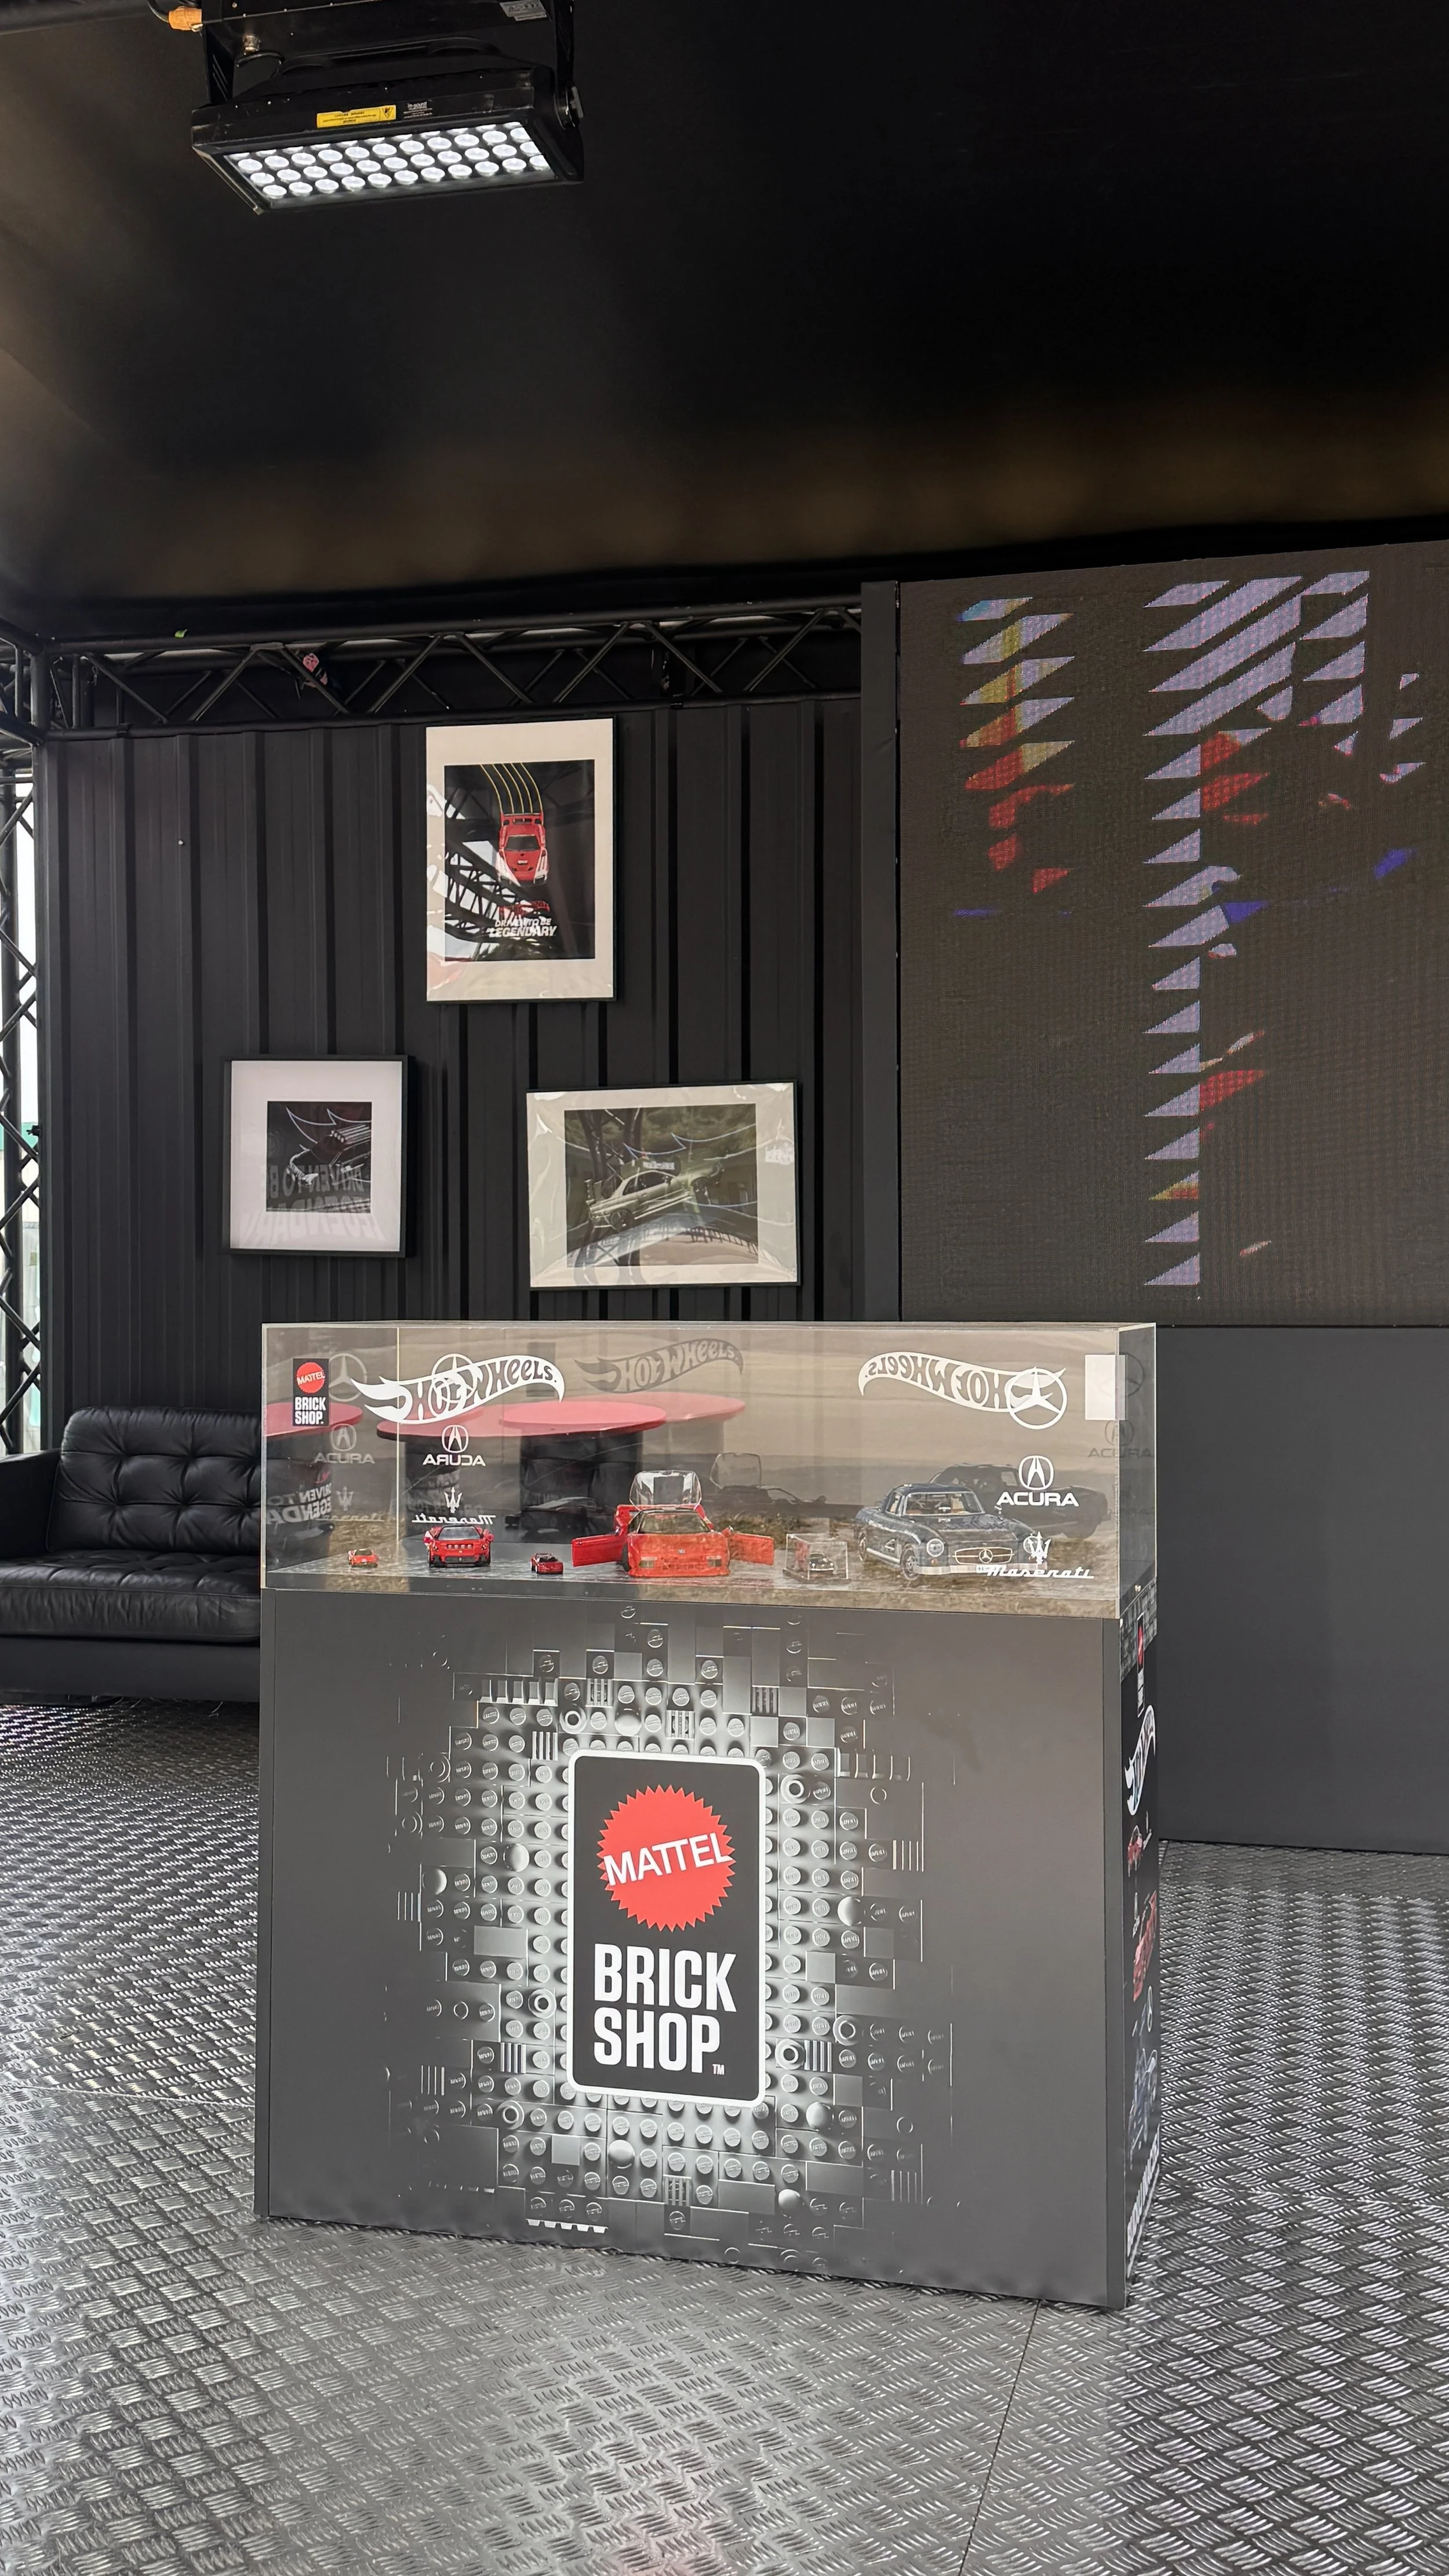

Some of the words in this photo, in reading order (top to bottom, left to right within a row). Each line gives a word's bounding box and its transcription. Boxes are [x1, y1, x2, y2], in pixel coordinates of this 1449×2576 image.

[297, 1370, 325, 1386] MATTEL
[295, 1397, 326, 1411] BRICK
[314, 1453, 375, 1464] ACURA
[996, 1491, 1079, 1507] ACURA
[984, 1566, 1094, 1579] Maserati
[603, 1832, 733, 1887] MATTEL
[594, 1943, 737, 2013] BRICK
